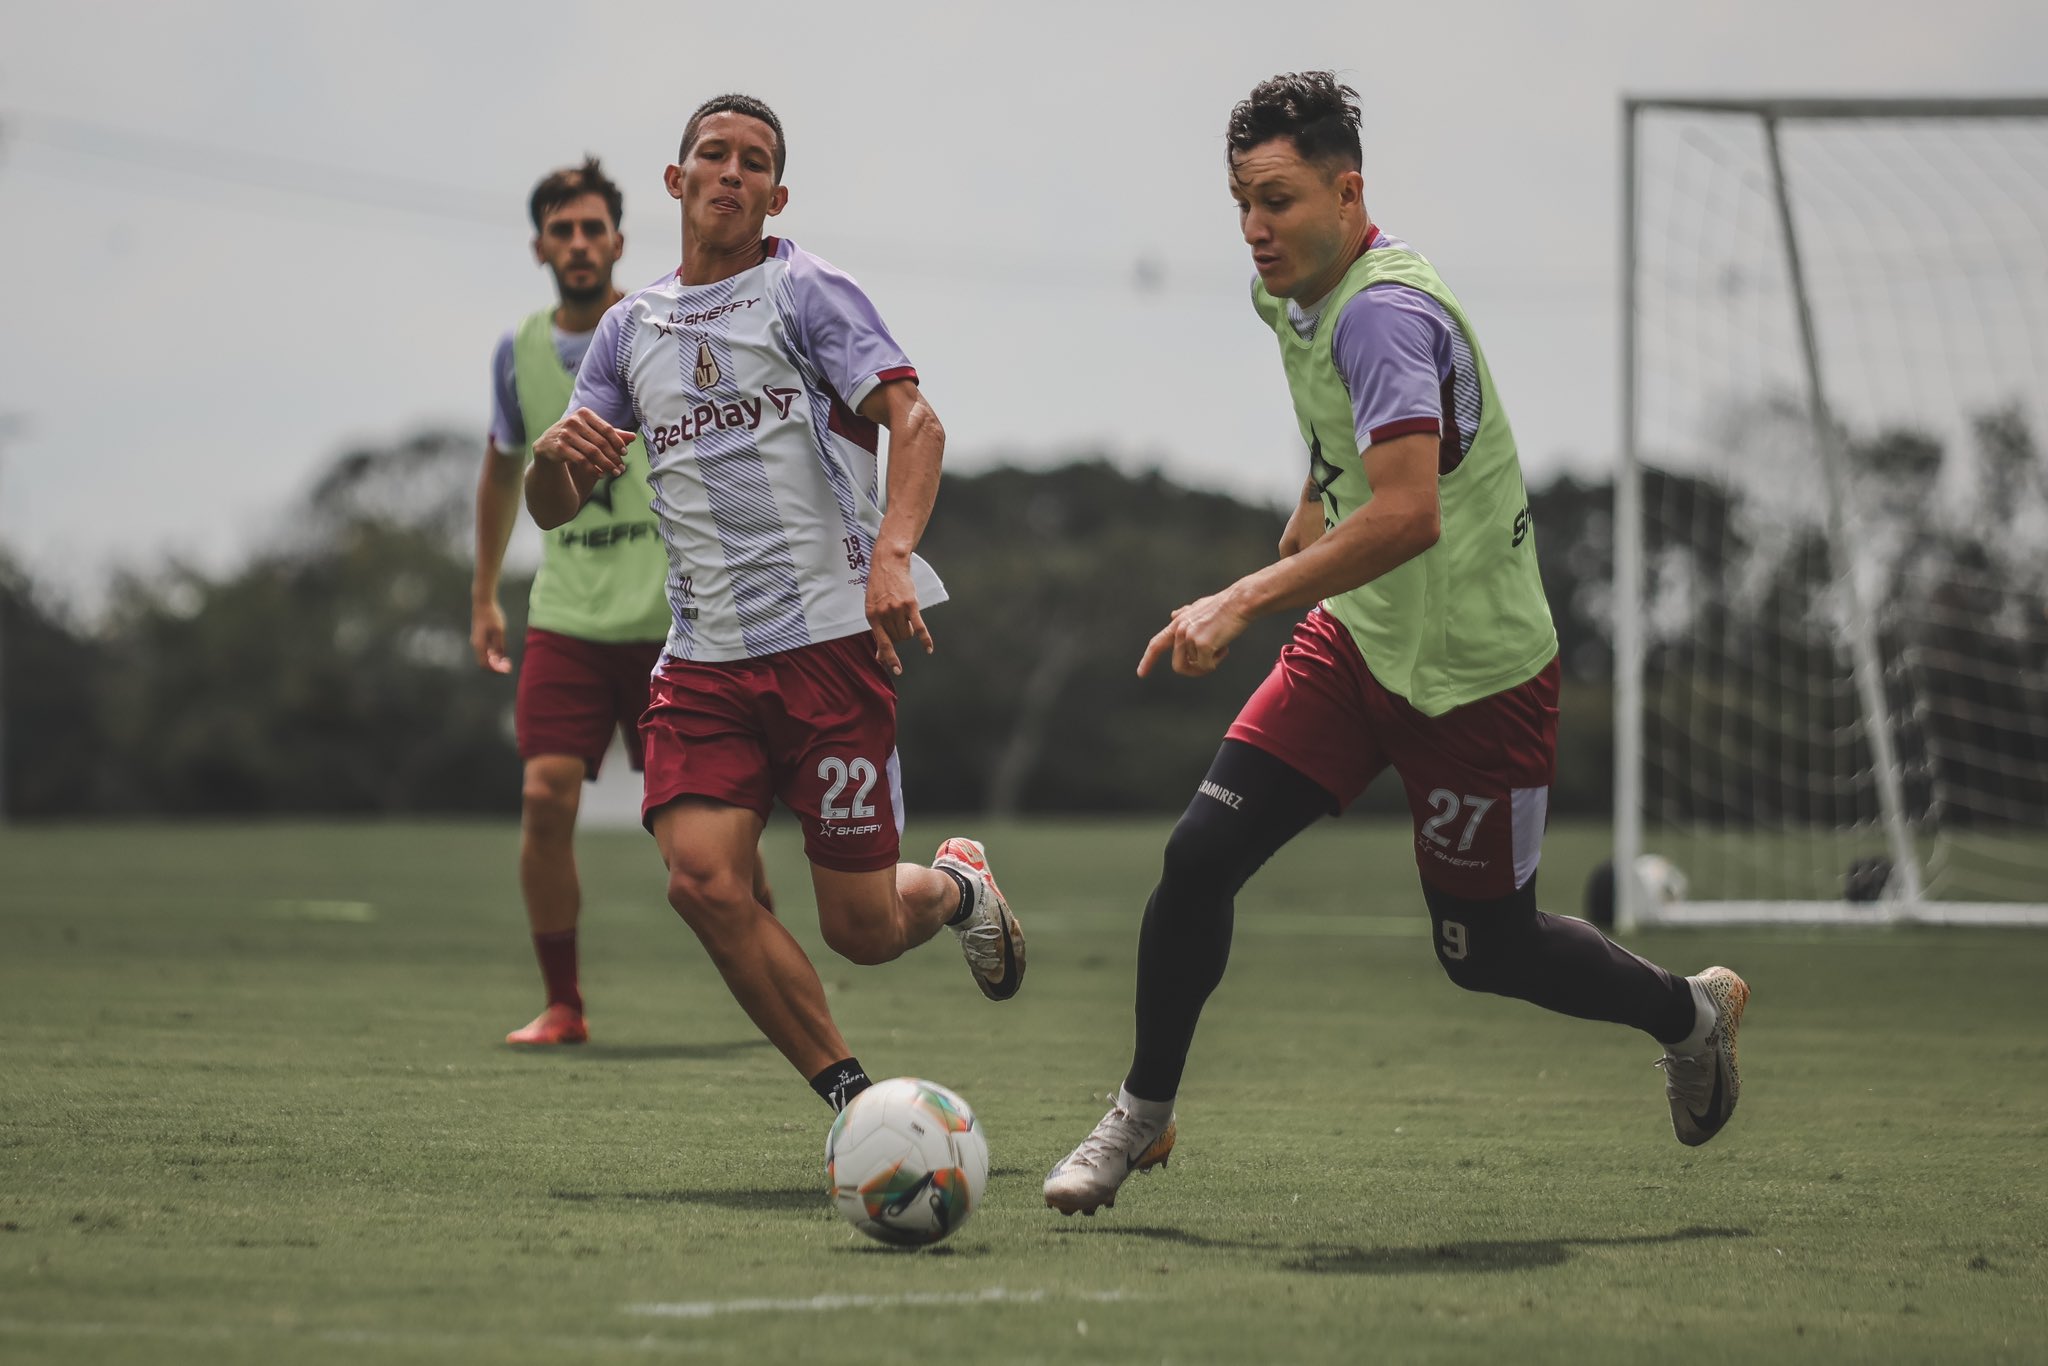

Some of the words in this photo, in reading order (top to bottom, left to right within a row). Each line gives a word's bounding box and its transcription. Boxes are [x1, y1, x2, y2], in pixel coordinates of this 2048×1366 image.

[684, 298, 760, 327] SHEFFY
[653, 396, 762, 455] BetPlay
[842, 535, 860, 553] 19
[847, 552, 866, 570] 54
[818, 757, 877, 818] 22
[837, 824, 882, 835] SHEFFY
[1421, 788, 1498, 851] 27
[1433, 850, 1490, 869] SHEFFY
[1442, 919, 1469, 960] 9
